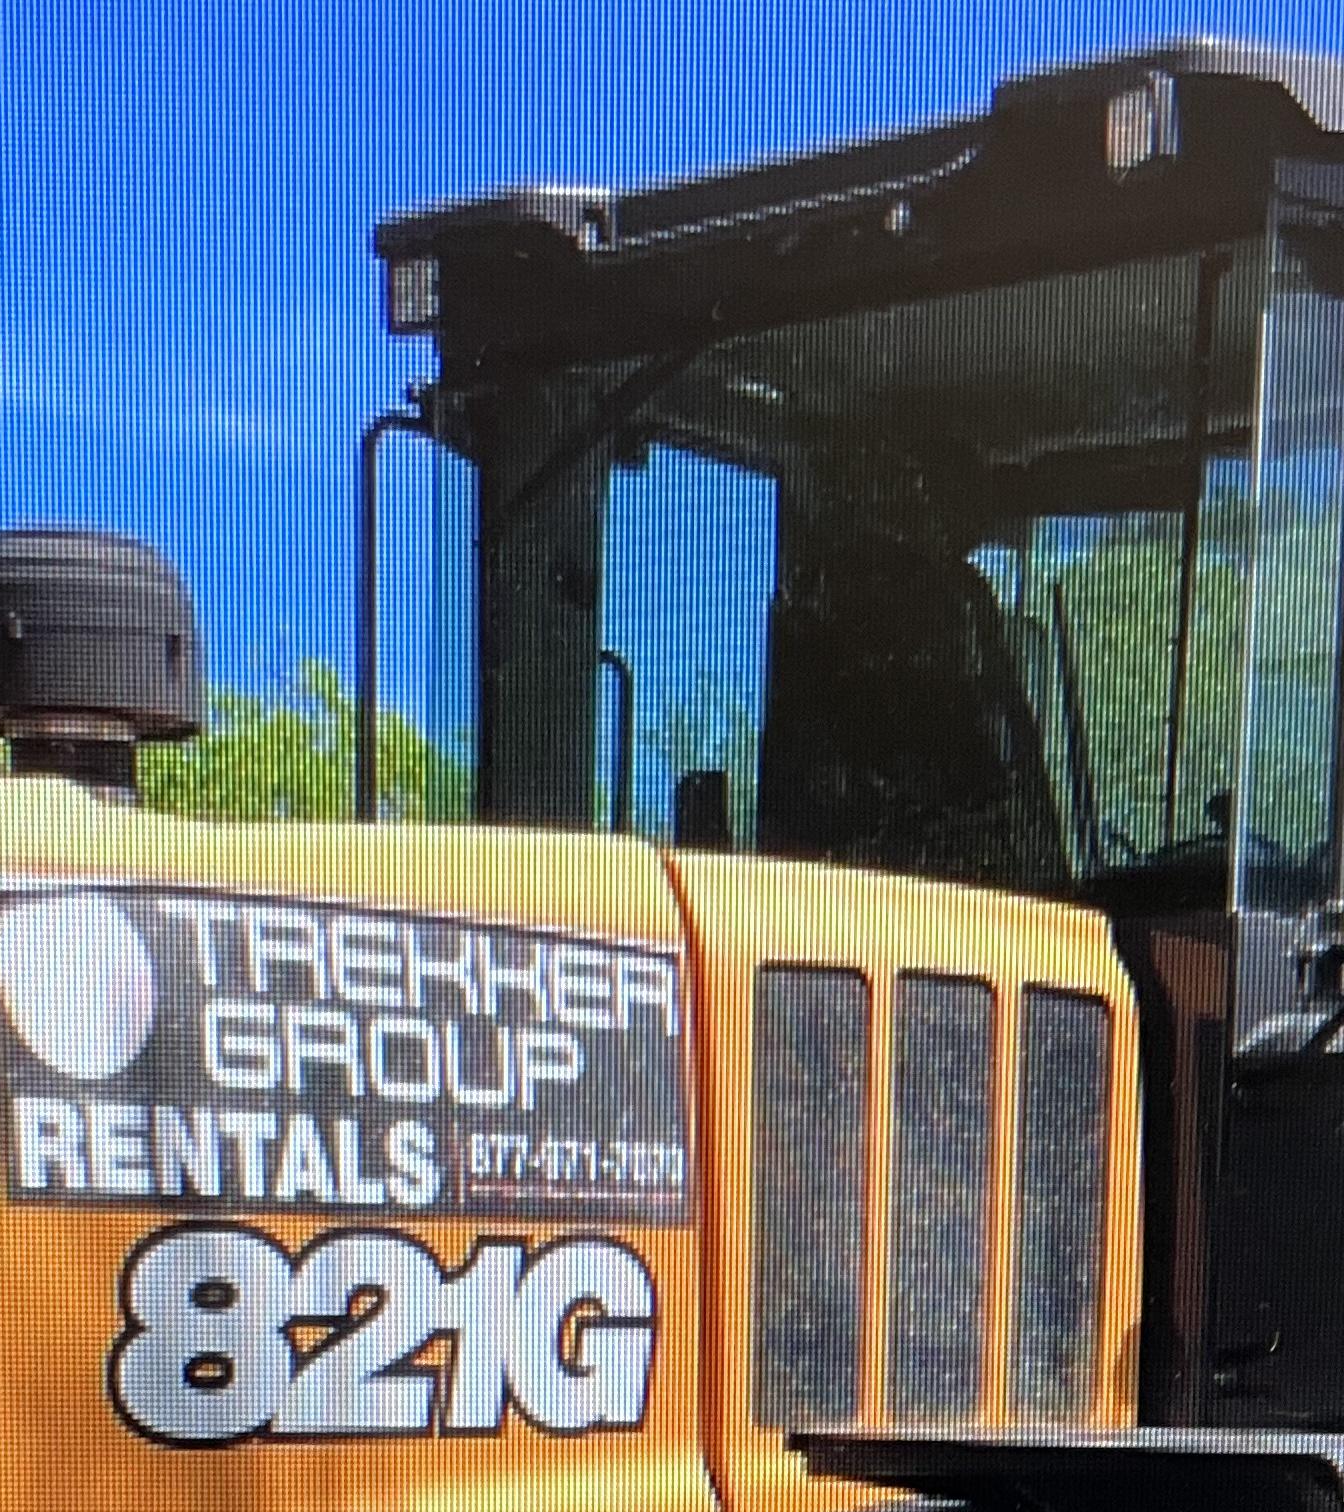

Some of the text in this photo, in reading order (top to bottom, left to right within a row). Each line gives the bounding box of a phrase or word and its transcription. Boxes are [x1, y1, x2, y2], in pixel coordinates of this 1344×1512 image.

[158, 897, 682, 1038] TREKKER
[203, 998, 586, 1111] GROUP
[13, 1097, 448, 1207] RENTALS
[106, 1220, 655, 1449] 821G
